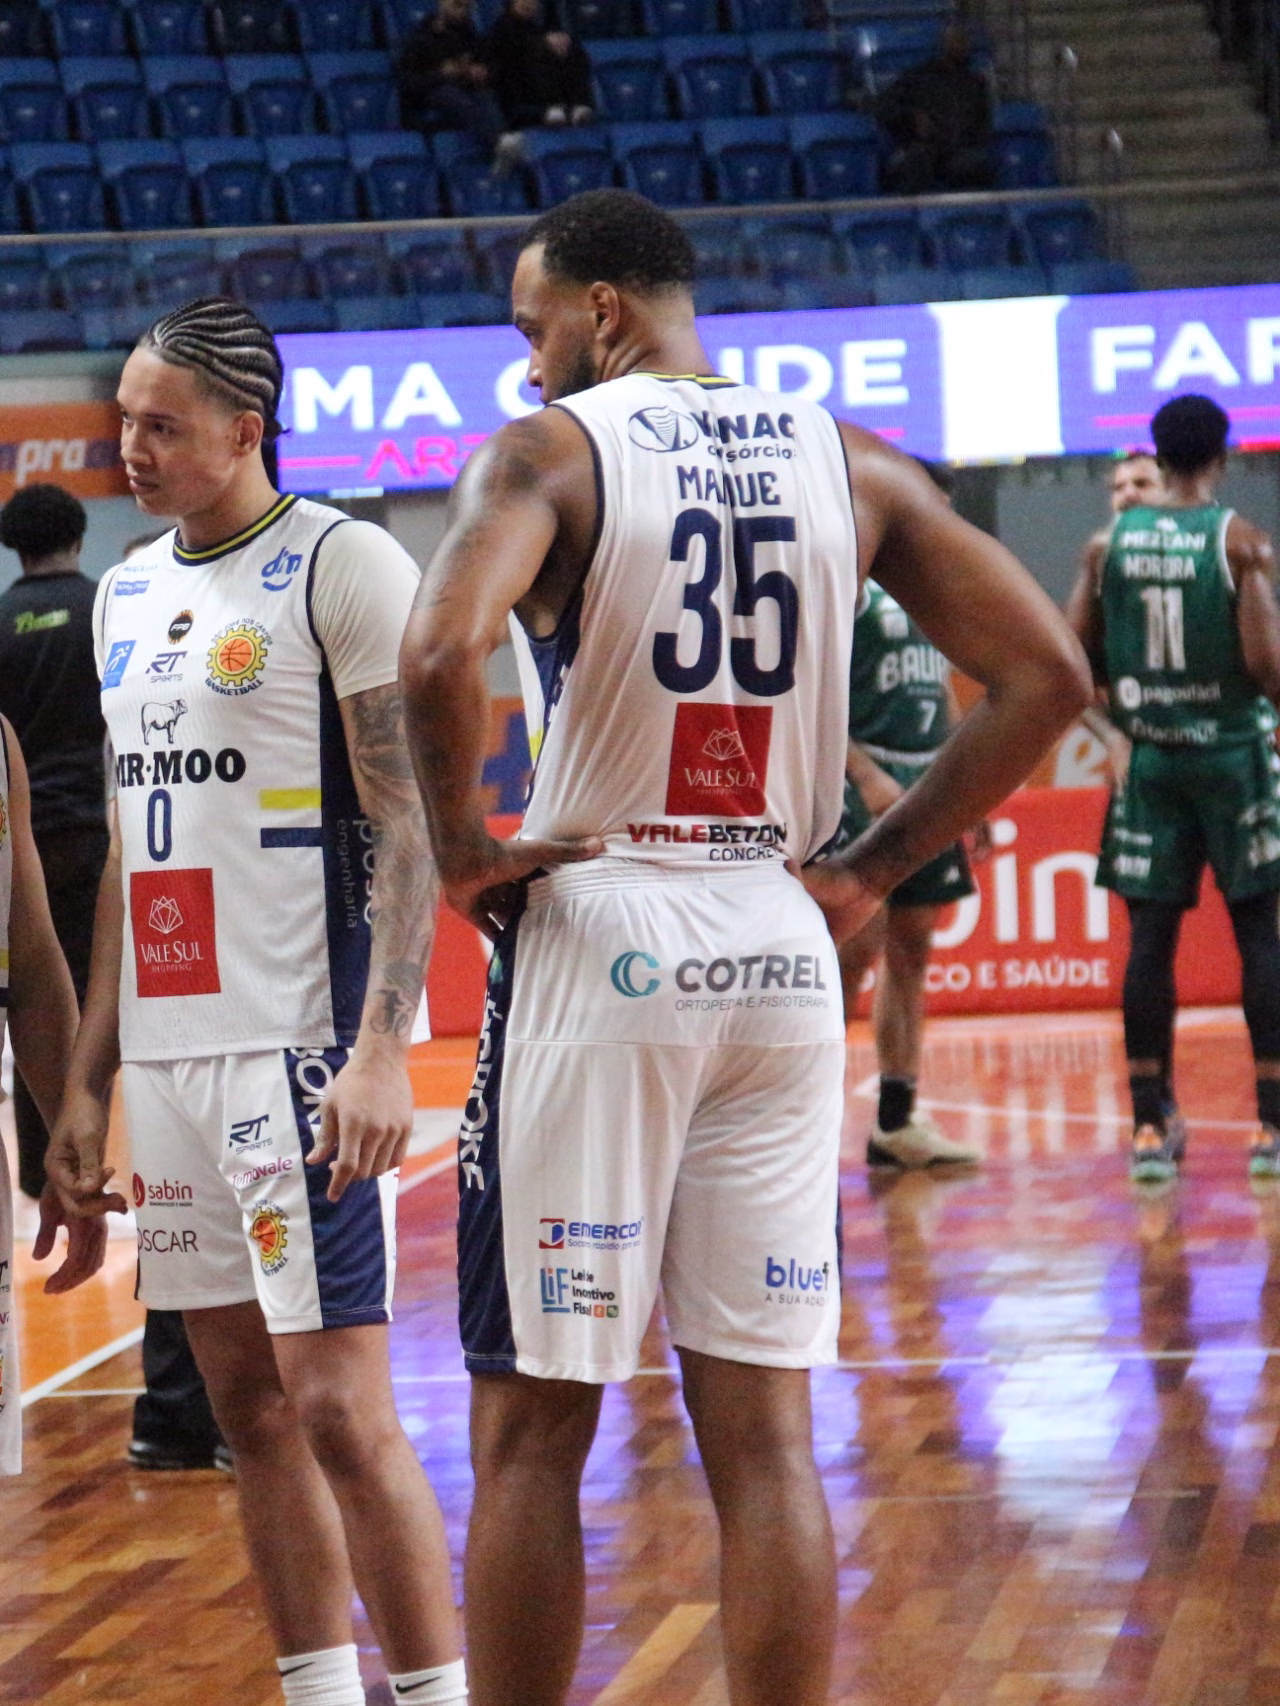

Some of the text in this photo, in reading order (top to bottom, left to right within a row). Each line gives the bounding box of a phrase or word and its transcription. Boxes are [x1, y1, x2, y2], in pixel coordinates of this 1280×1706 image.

[653, 507, 799, 697] 35
[1140, 586, 1187, 671] 11
[920, 700, 938, 734] 7
[147, 788, 172, 863] 0
[675, 954, 827, 993] COTREL
[978, 961, 997, 989] E
[1003, 954, 1111, 989] SAÚDE
[228, 1113, 270, 1149] RT
[235, 1137, 274, 1155] SPORTS
[148, 1178, 193, 1200] sabin
[764, 1293, 773, 1303] A
[778, 1293, 801, 1305] SUA
